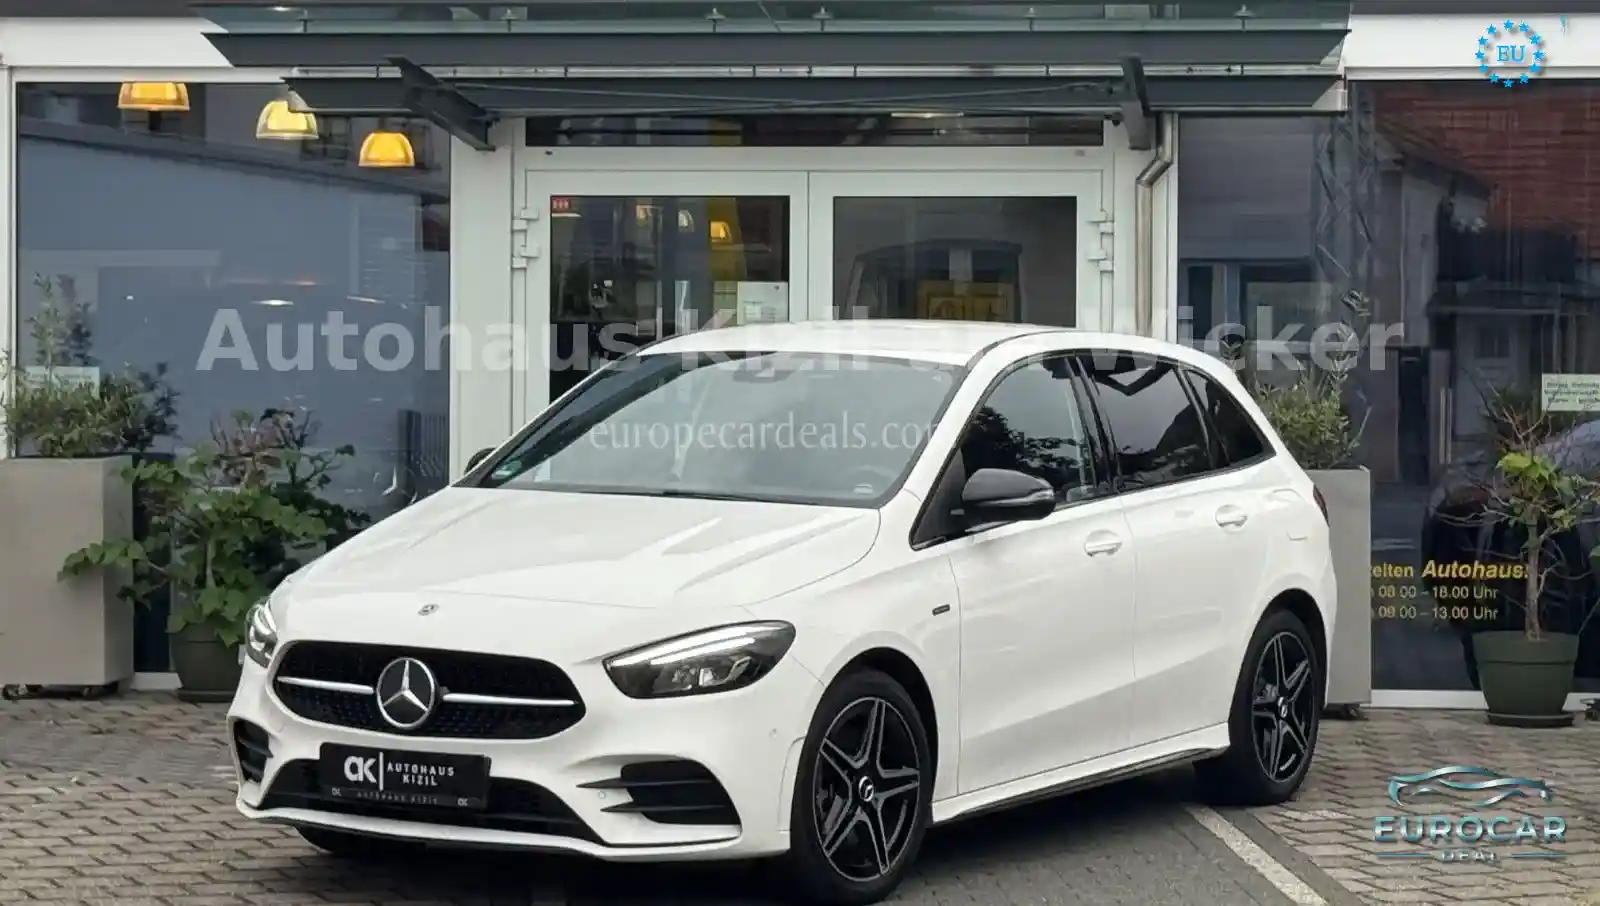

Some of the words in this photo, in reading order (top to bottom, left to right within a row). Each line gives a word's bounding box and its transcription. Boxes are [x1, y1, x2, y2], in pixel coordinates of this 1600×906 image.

[1370, 562, 1414, 578] eiten
[1433, 585, 1469, 598] 18.00
[1473, 585, 1499, 598] Uhr
[1433, 606, 1469, 619] 13.00
[1473, 606, 1499, 619] Uhr
[386, 762, 455, 777] AUTOHAUS
[402, 775, 438, 786] KIZIL
